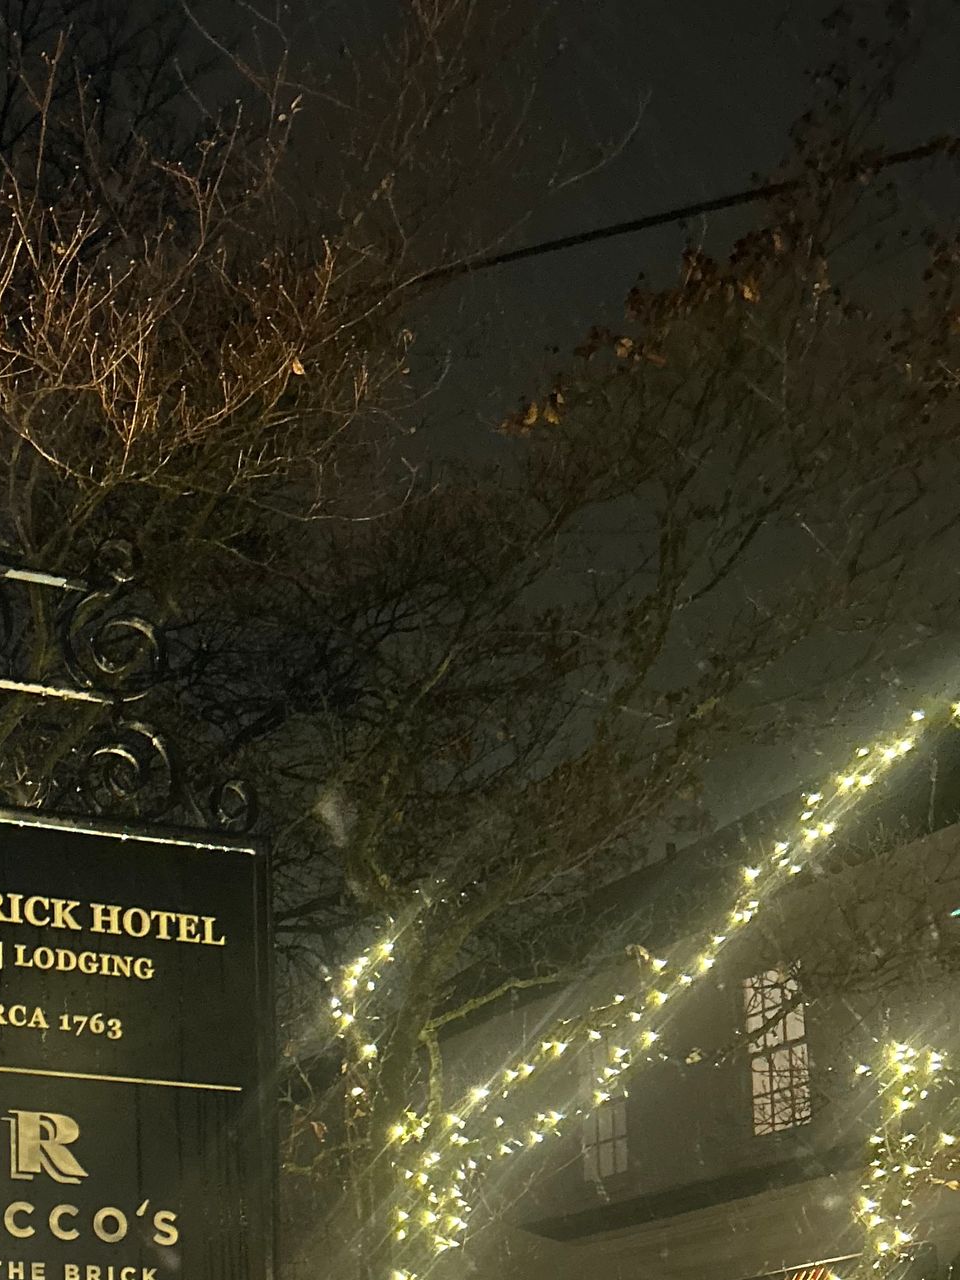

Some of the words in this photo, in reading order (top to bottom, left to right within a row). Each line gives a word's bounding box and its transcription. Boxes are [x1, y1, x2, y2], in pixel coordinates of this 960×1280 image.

[89, 902, 226, 946] HOTEL
[13, 943, 156, 980] LODGING
[58, 1012, 123, 1040] 1763
[0, 1109, 89, 1185] R
